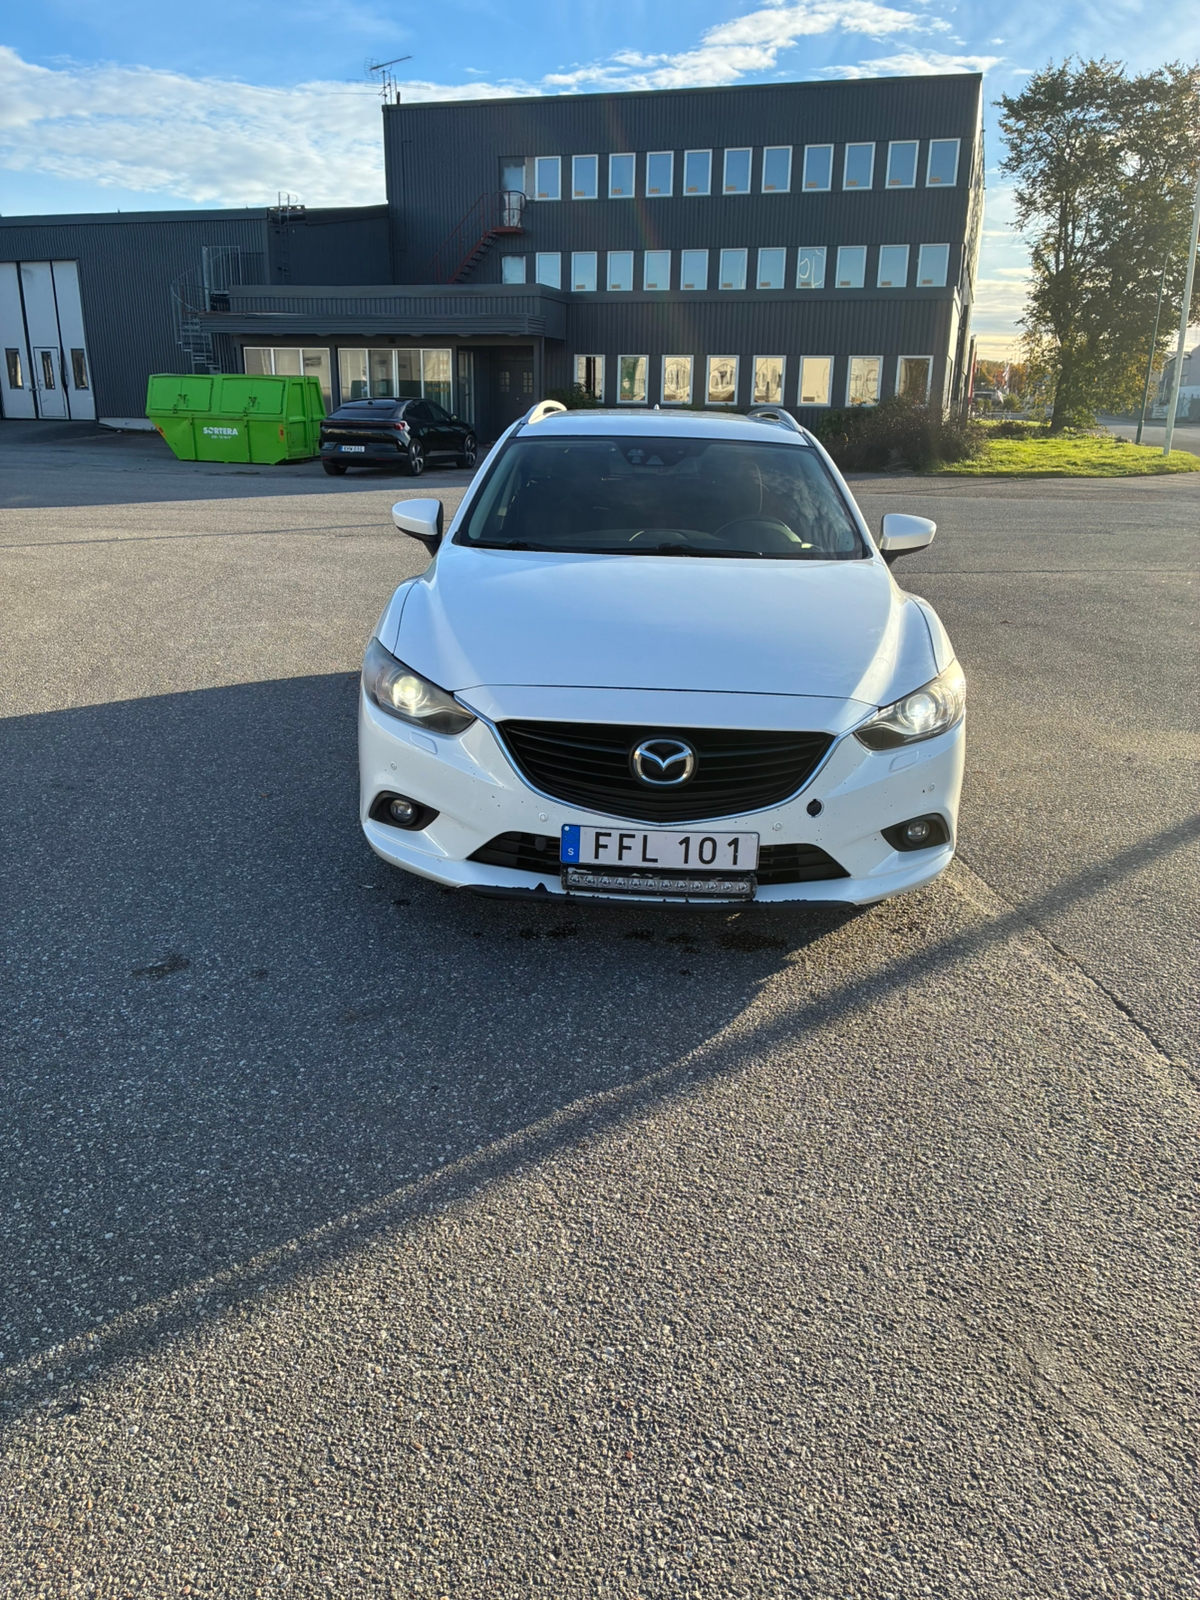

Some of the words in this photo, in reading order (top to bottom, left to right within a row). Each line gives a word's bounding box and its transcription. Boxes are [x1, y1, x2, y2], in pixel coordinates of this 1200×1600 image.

[203, 426, 239, 436] SORTERA
[567, 848, 574, 856] S
[594, 831, 659, 864] FFL
[678, 836, 740, 866] 101
